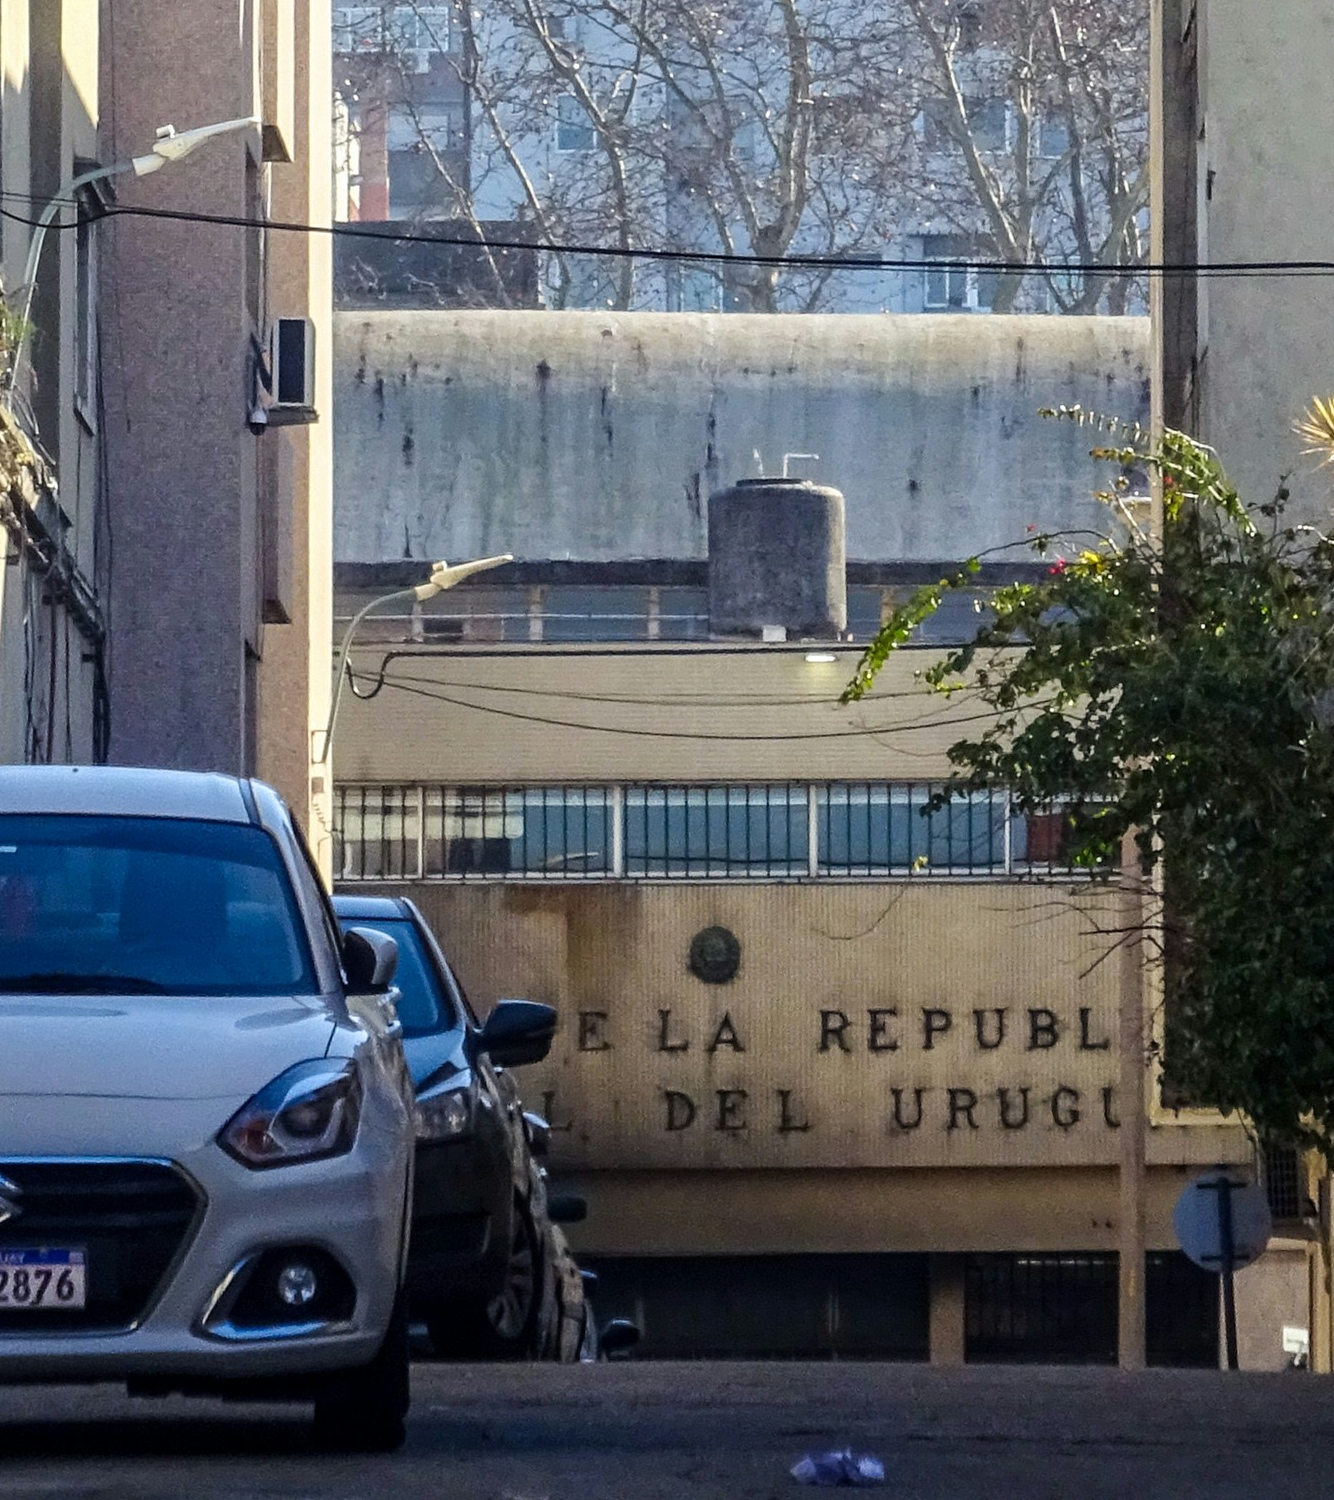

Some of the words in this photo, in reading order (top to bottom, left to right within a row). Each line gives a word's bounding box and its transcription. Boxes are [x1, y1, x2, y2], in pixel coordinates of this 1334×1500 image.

[657, 1009, 746, 1053] LA
[816, 1008, 1110, 1053] REPUBL
[664, 1089, 815, 1132] DEL
